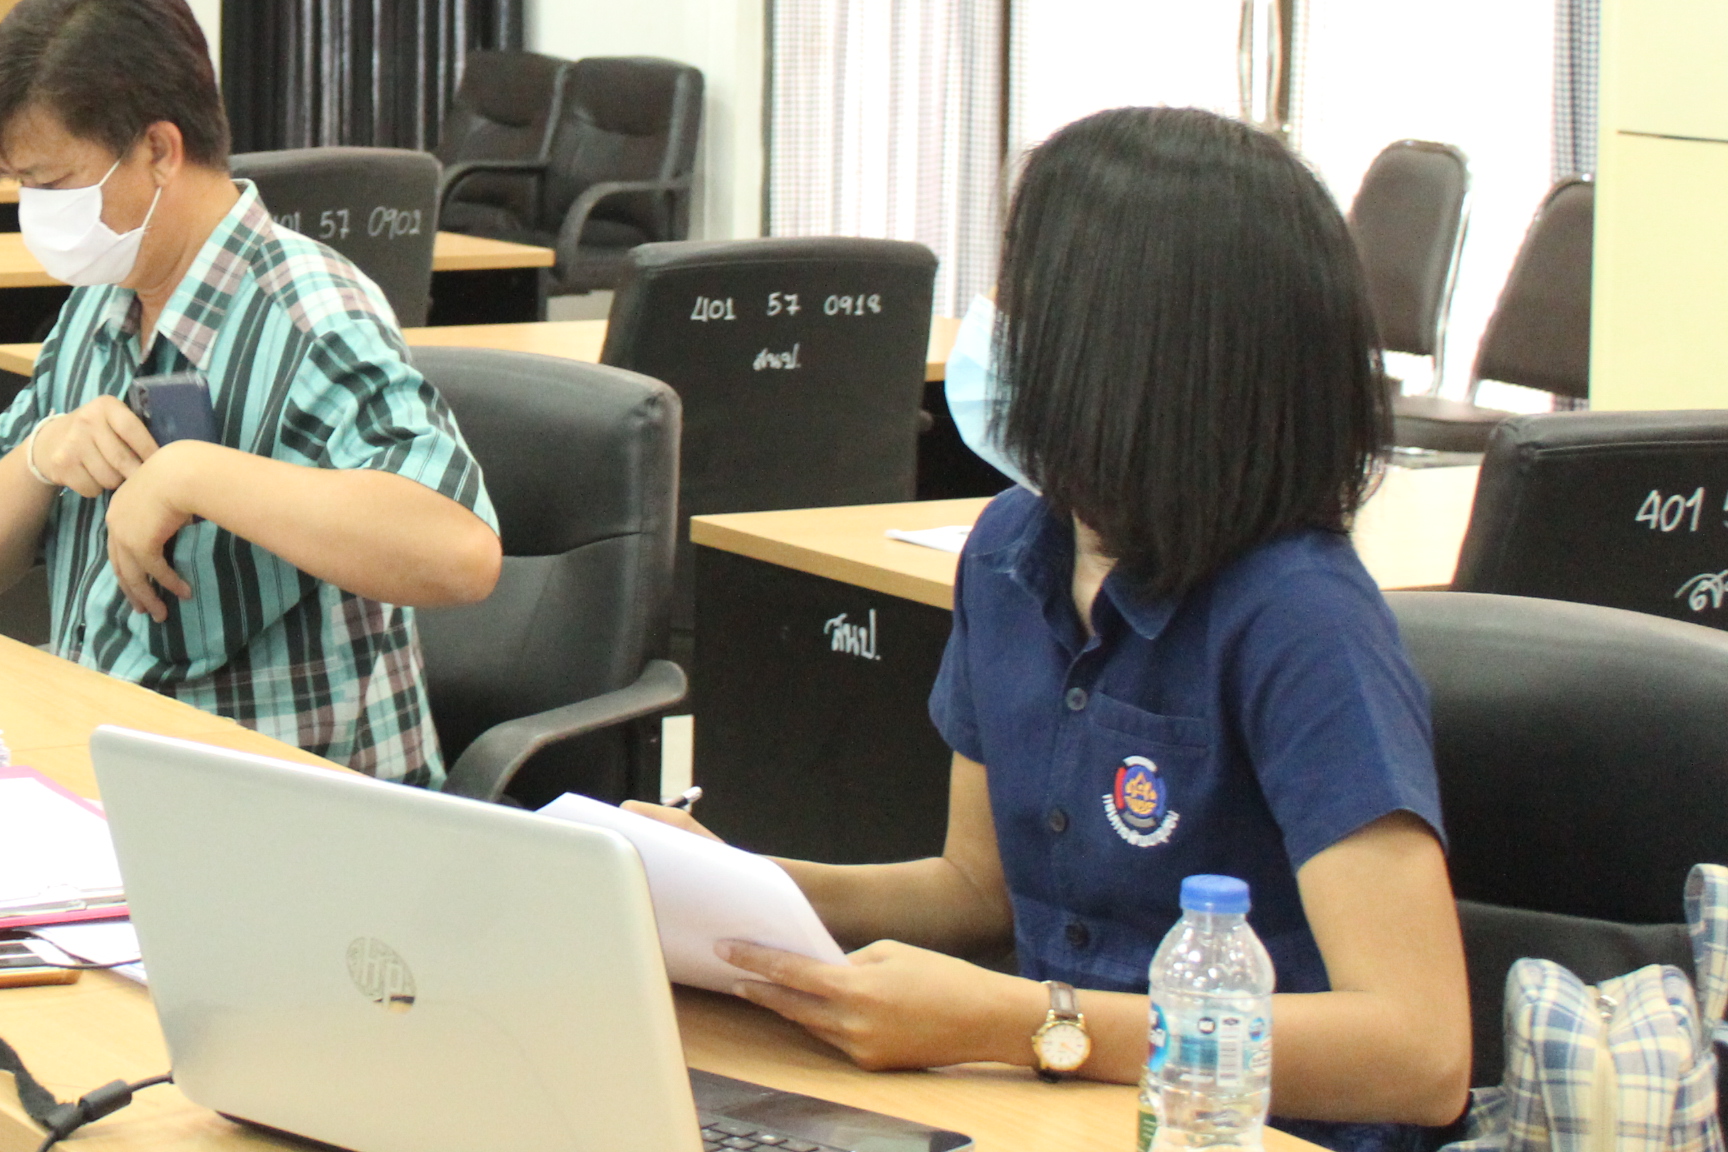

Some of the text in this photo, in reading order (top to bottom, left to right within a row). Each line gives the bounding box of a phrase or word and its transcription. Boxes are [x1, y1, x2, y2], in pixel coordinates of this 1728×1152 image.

[319, 208, 351, 240] 57
[690, 291, 882, 322] 401 57 0918
[1634, 486, 1706, 533] 401
